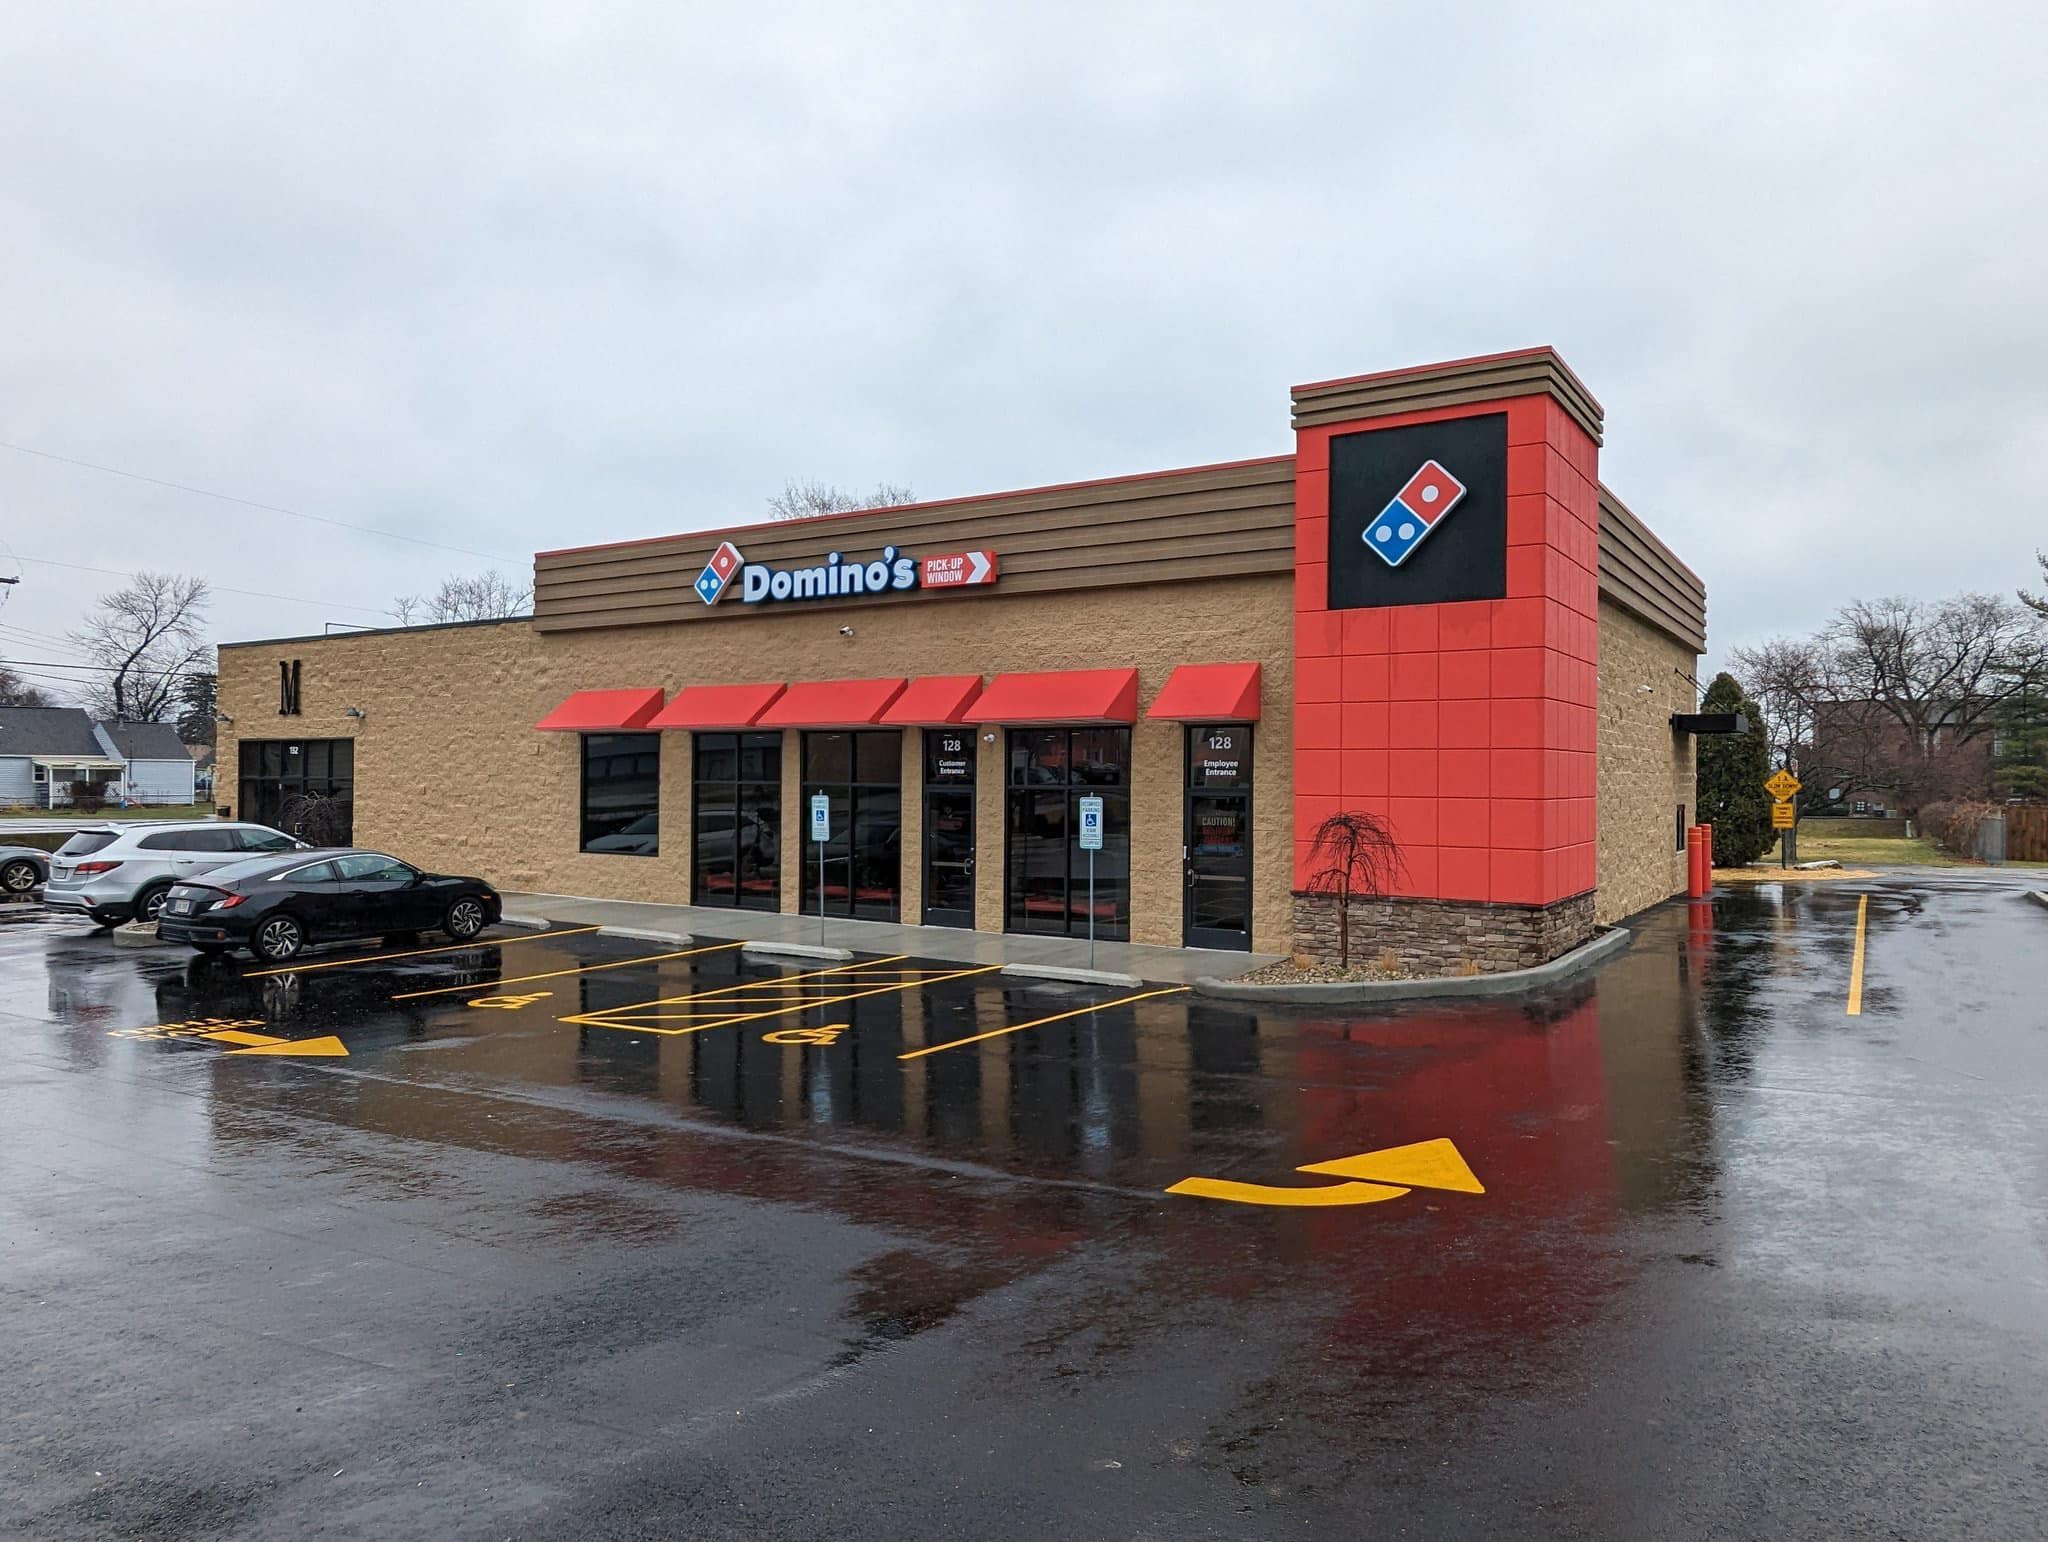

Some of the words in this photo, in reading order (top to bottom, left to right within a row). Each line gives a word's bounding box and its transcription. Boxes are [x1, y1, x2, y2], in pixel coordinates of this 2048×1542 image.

[927, 558, 963, 572] PICK-UP
[743, 546, 917, 604] Domino's
[927, 571, 963, 584] WINDOW
[279, 660, 301, 715] M
[943, 740, 961, 752] 128
[1209, 737, 1232, 750] 128
[1204, 760, 1238, 769] Employee
[1202, 816, 1236, 827] CAUTION!
